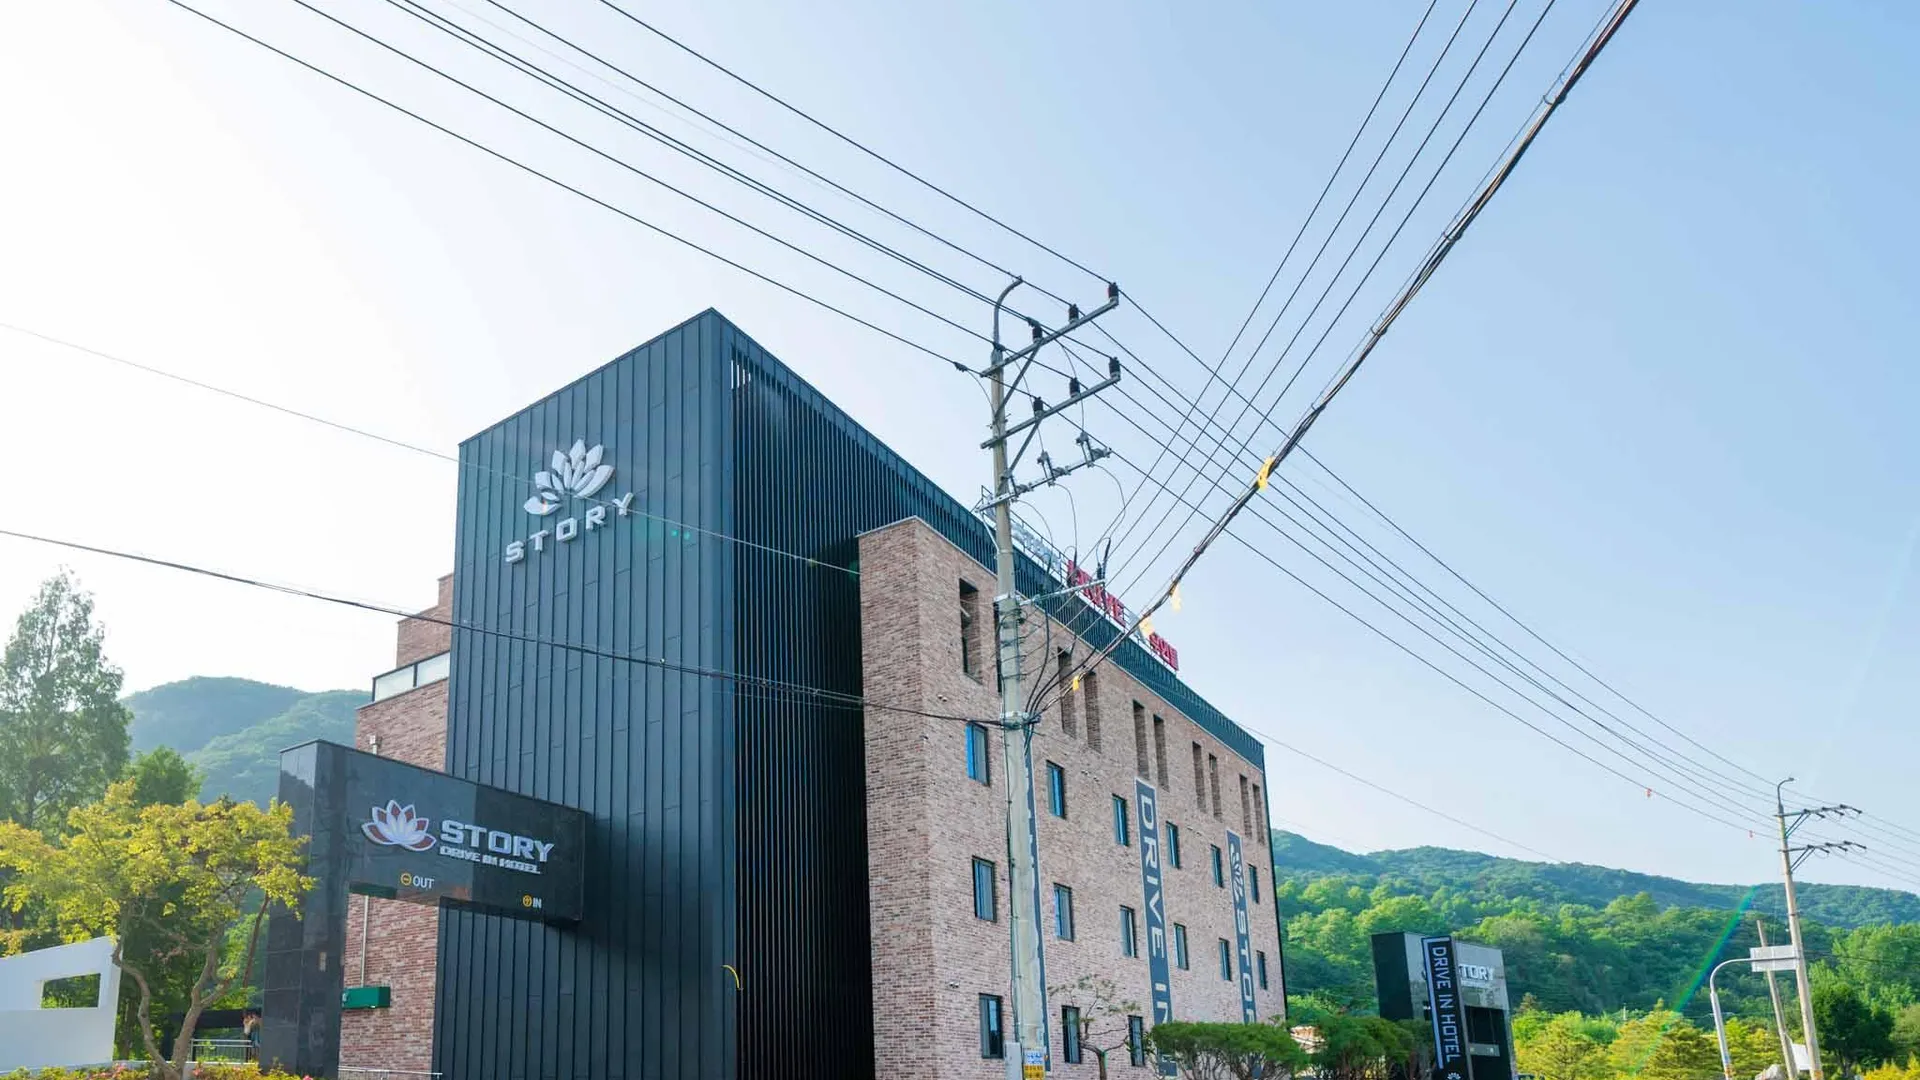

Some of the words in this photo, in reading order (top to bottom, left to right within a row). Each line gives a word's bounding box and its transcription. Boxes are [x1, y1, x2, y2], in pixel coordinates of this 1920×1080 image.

[505, 492, 634, 563] STORY
[439, 845, 481, 862] DRIVE
[440, 819, 555, 863] STORY
[412, 875, 435, 889] OUT
[1140, 794, 1164, 958] DRIVE
[532, 897, 542, 909] IN
[1432, 946, 1452, 990] DRIVE
[1438, 994, 1453, 1009] IN
[1440, 1014, 1461, 1062] HOTEL
